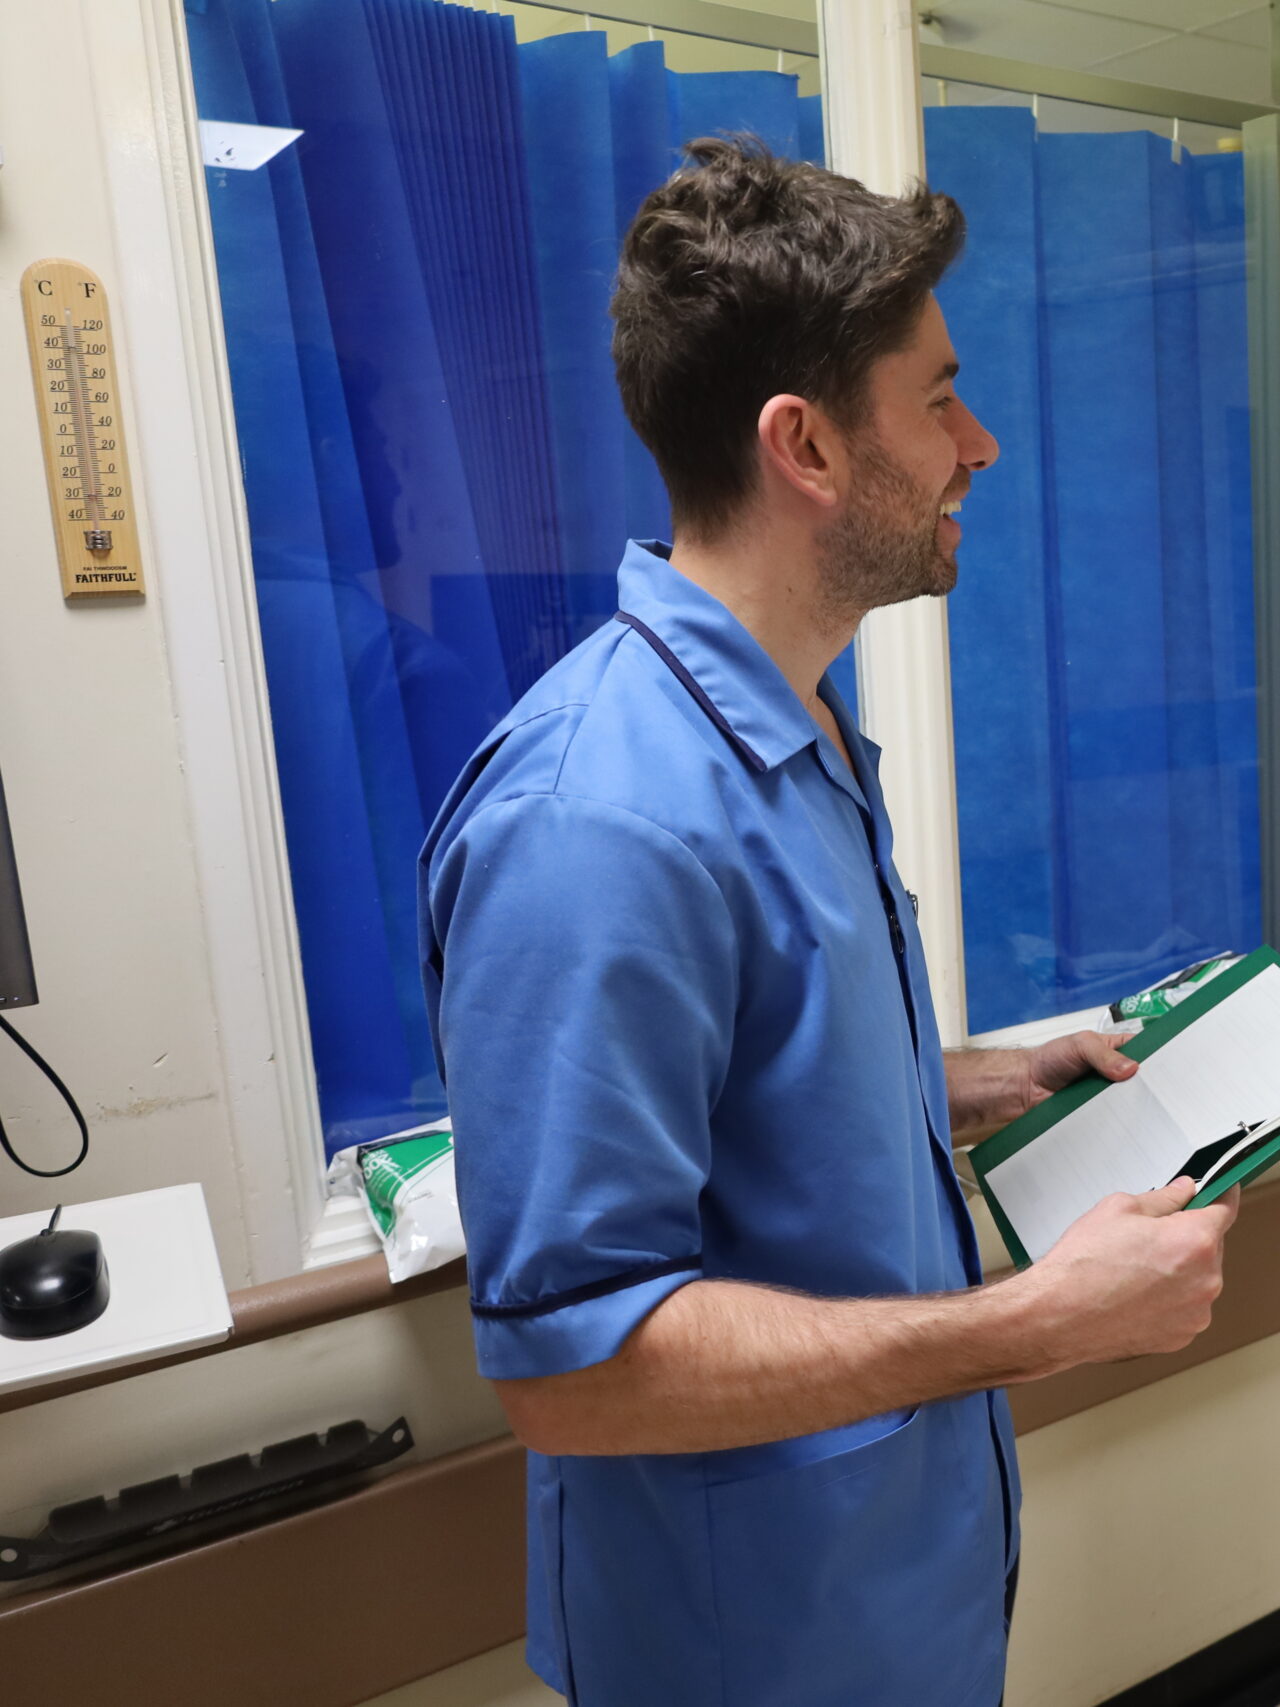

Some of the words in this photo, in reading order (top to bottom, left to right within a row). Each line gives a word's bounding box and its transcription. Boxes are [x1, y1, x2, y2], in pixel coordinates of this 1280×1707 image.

[41, 315, 56, 325] 50
[83, 320, 103, 330] 120
[44, 337, 59, 347] 40
[86, 344, 107, 354] 100
[47, 358, 62, 368] 30
[92, 368, 106, 378] 80
[50, 380, 65, 391] 20
[95, 392, 109, 402] 60
[54, 402, 68, 412] 10
[98, 416, 112, 426] 40
[60, 423, 67, 434] 0
[60, 445, 74, 455] 10
[101, 440, 116, 450] 20
[62, 466, 77, 476] 20
[108, 463, 115, 473] 0
[65, 487, 80, 498] 30
[108, 486, 122, 496] 20
[68, 509, 83, 519] 40
[111, 509, 125, 520] 40
[75, 573, 136, 583] FAITHFULL
